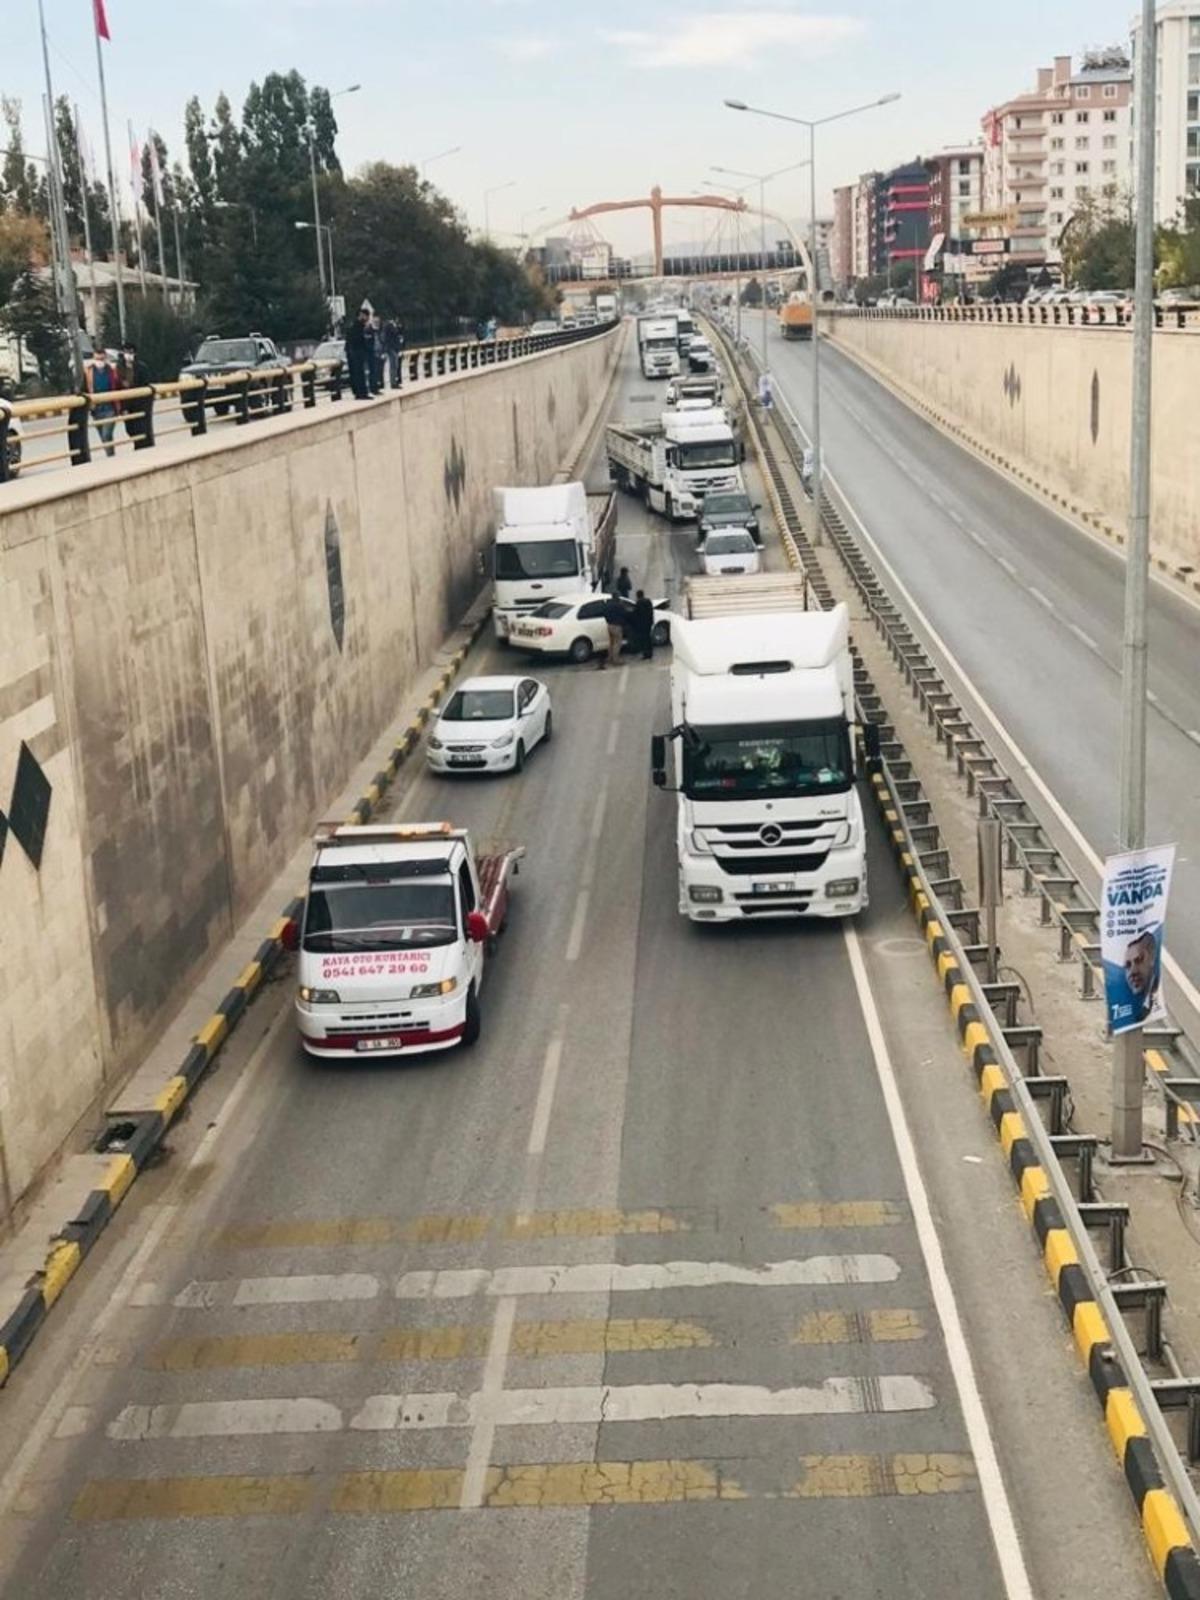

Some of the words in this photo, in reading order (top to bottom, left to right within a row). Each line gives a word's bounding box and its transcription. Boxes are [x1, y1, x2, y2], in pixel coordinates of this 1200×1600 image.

[1107, 882, 1163, 907] VANDA
[322, 957, 350, 967] KAYA
[352, 955, 372, 964] OTO
[374, 952, 431, 962] KURTARICI
[323, 966, 355, 979] 0541
[358, 964, 384, 975] 647
[409, 963, 428, 974] 60
